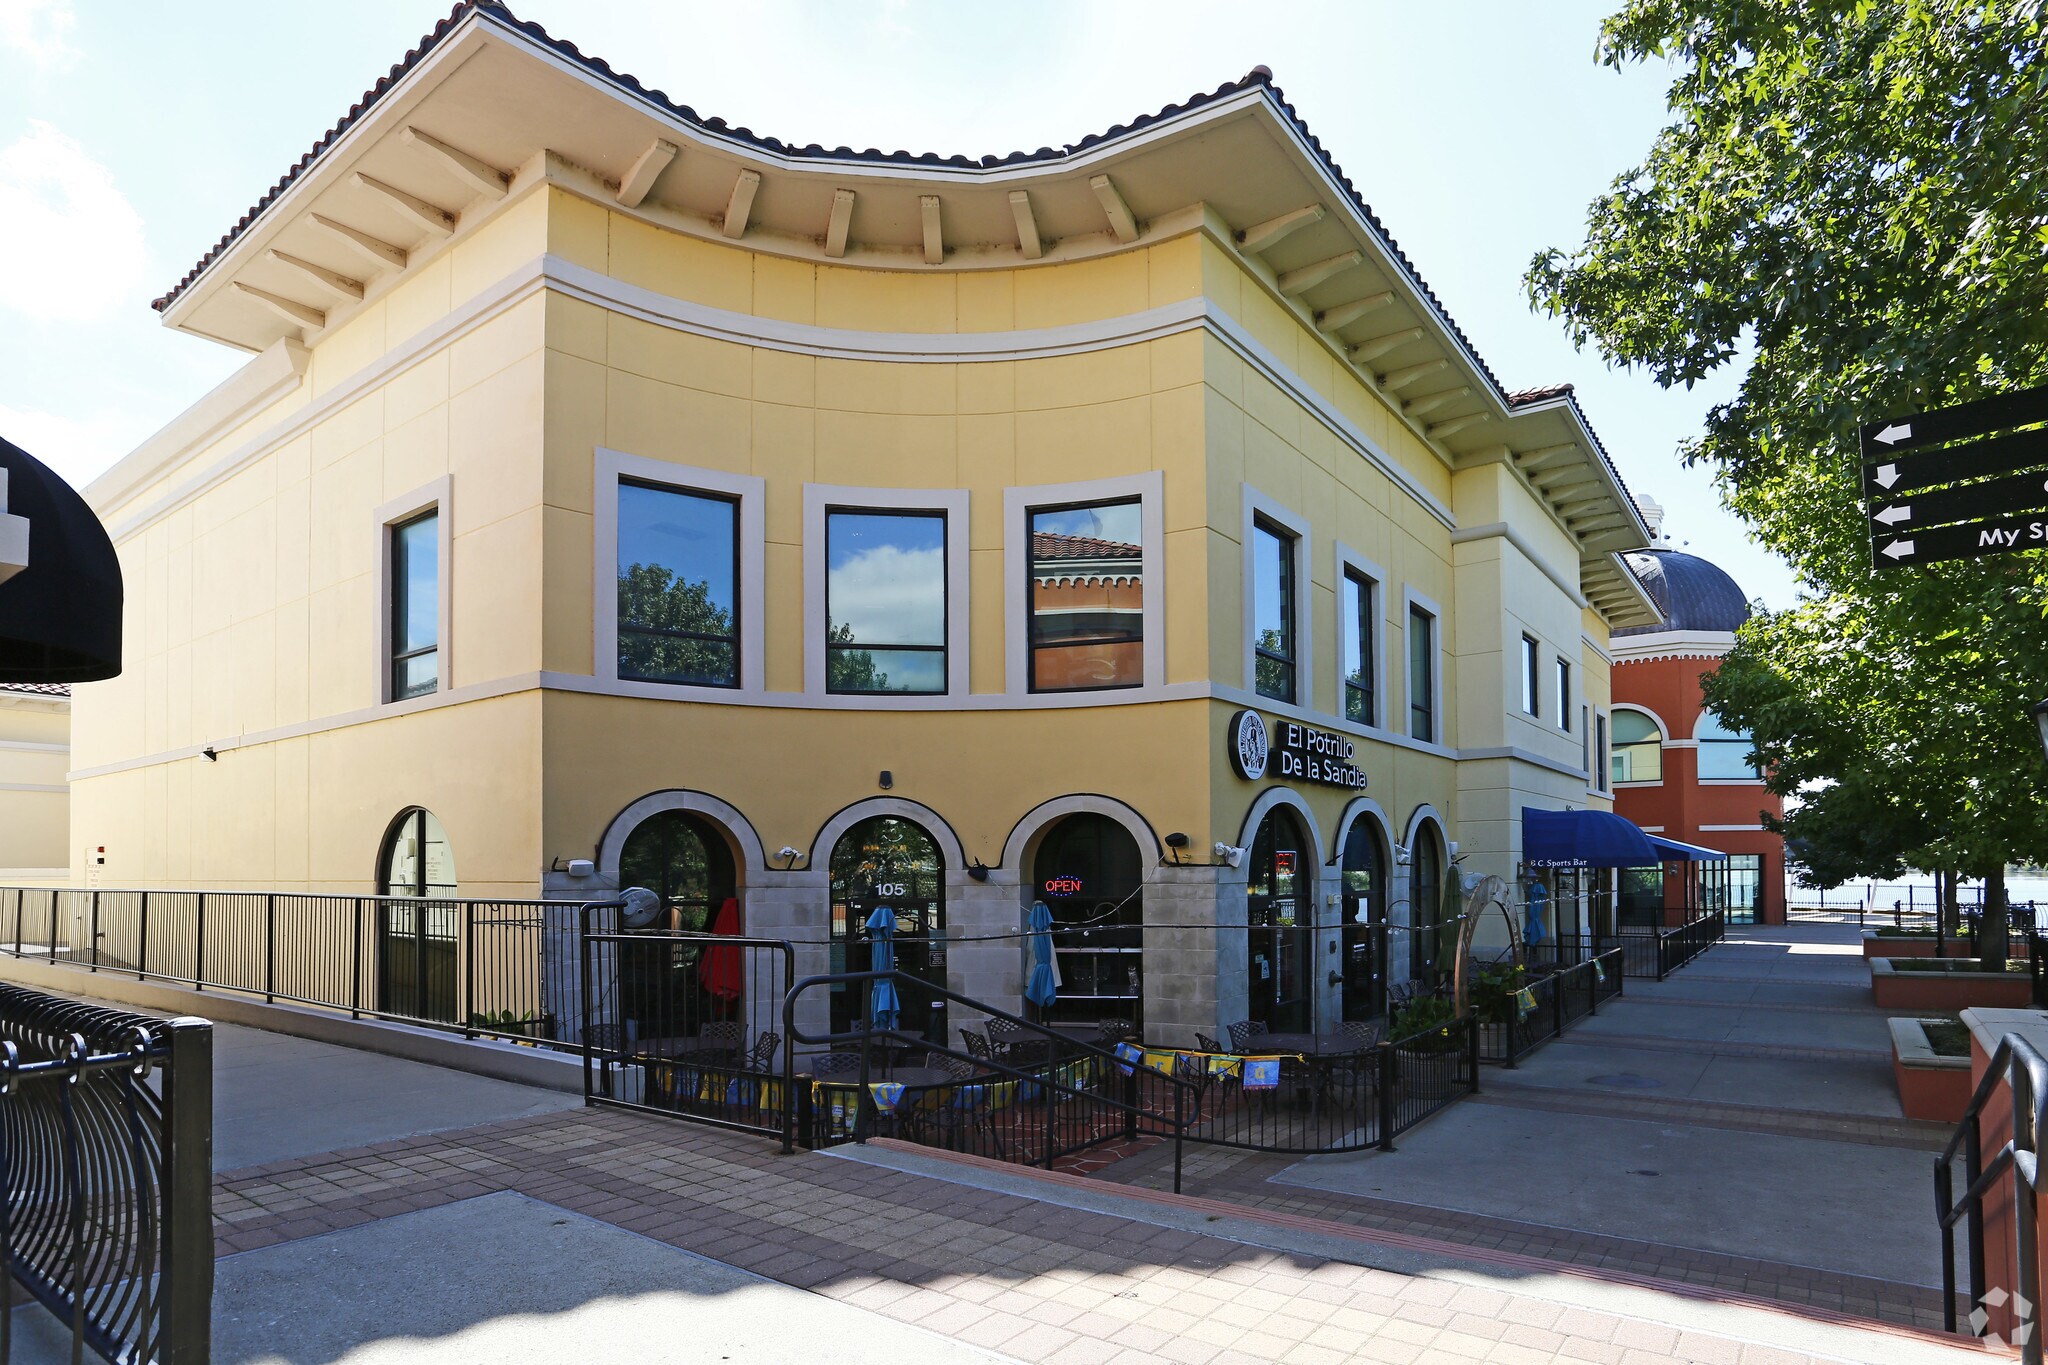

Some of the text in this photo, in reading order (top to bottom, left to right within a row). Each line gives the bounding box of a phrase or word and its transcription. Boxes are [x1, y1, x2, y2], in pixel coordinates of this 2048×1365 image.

[1979, 528, 2020, 546] My
[1287, 723, 1302, 748] El
[1306, 728, 1354, 759] Potrillo
[1281, 750, 1366, 787] De la Sandia
[1546, 860, 1571, 868] Sports
[1573, 858, 1587, 866] Bar
[875, 883, 904, 896] 105
[1045, 880, 1080, 891] OPEN
